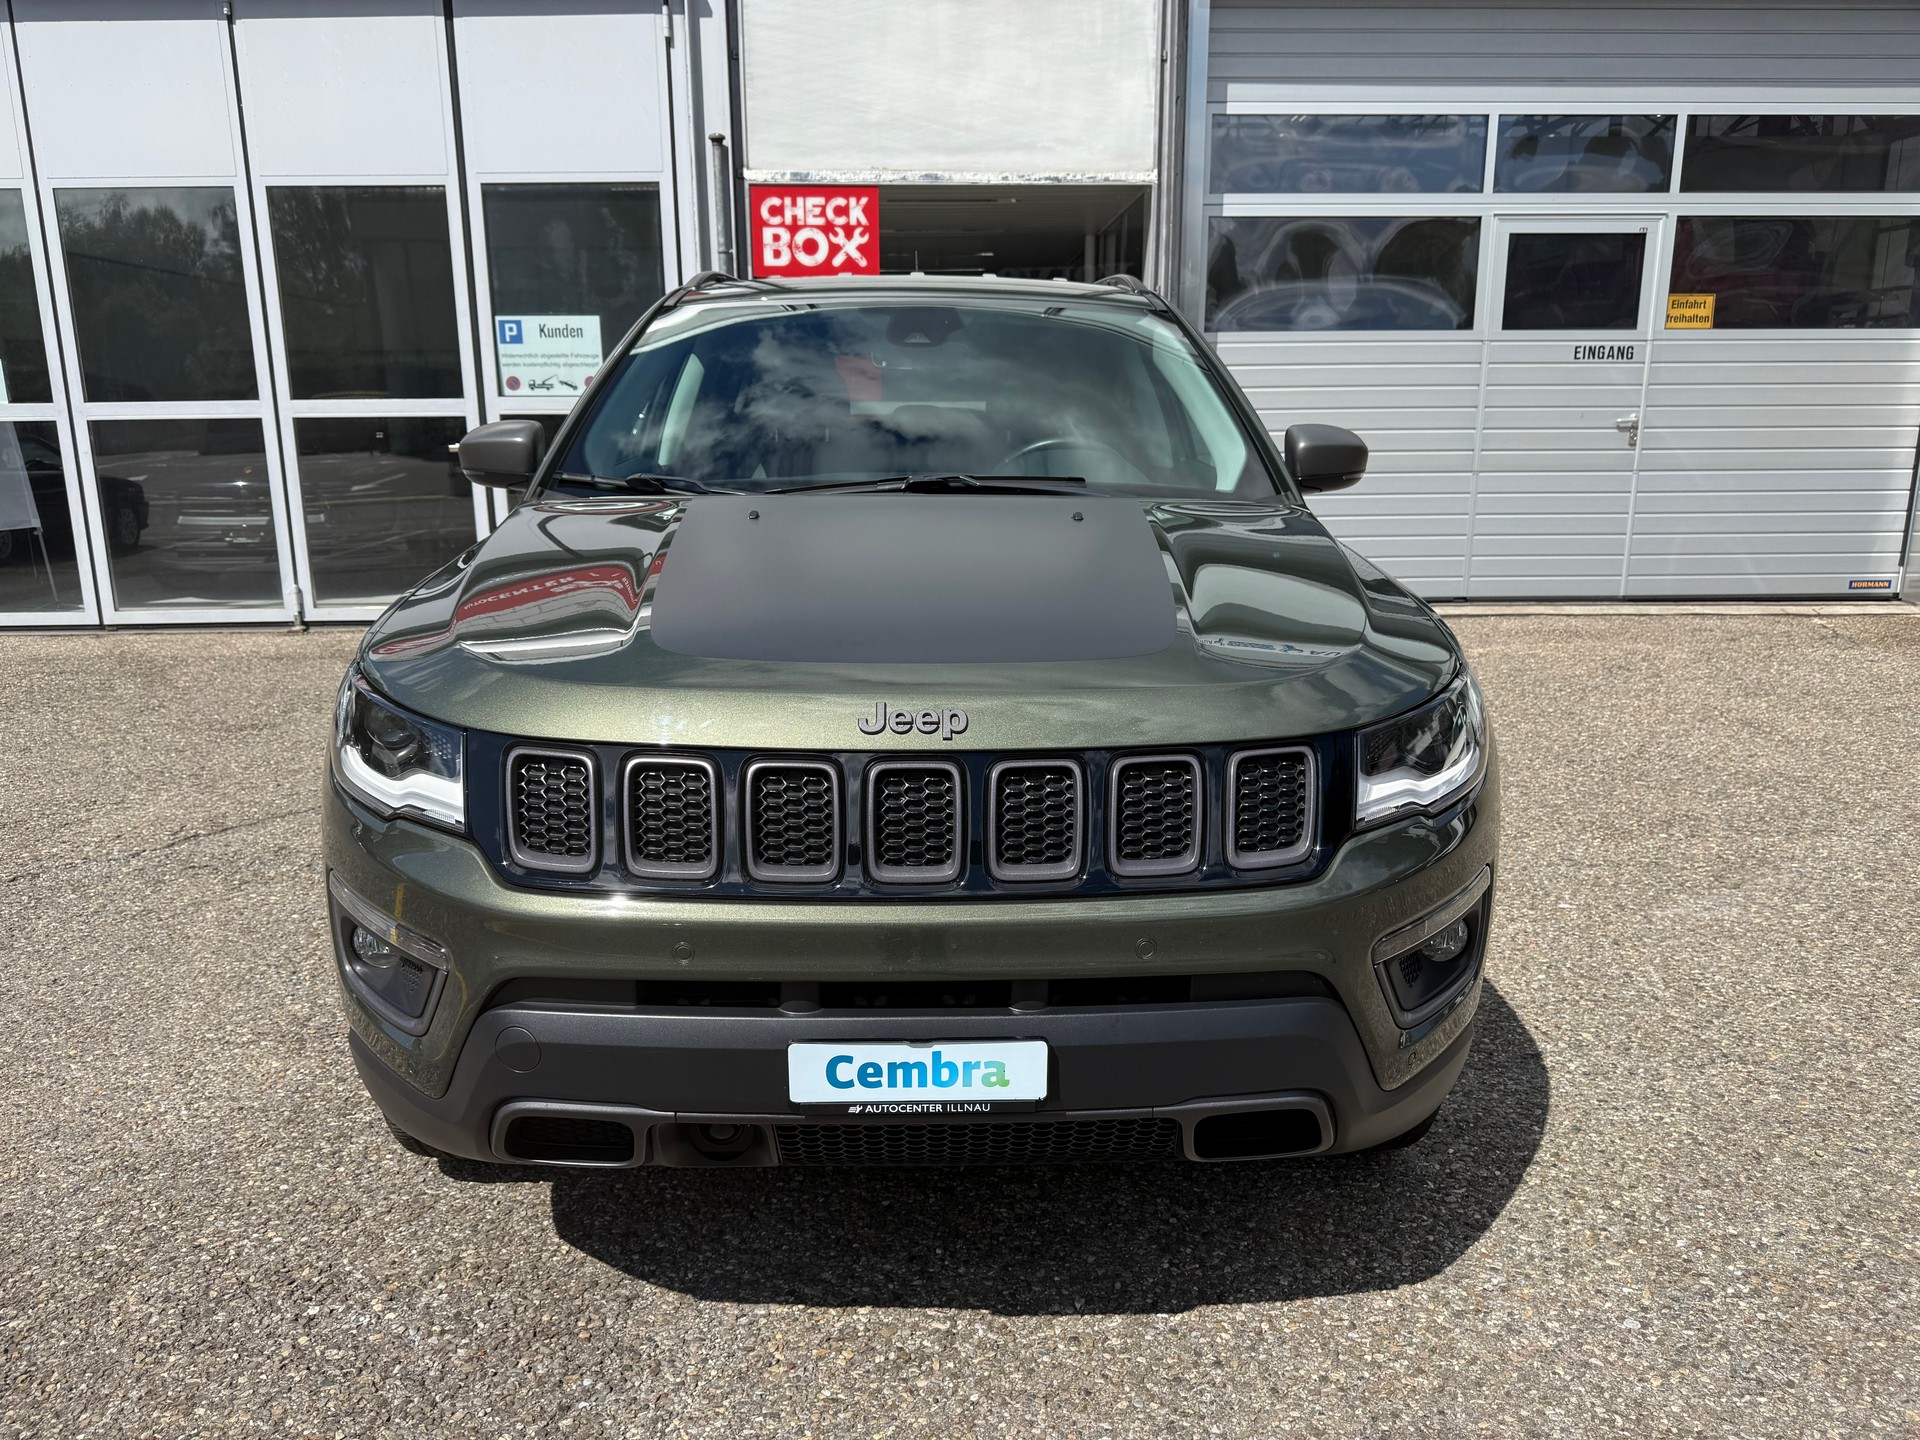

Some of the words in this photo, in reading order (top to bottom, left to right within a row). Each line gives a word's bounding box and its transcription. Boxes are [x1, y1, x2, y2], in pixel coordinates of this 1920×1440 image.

[760, 196, 870, 226] CHECK
[762, 226, 870, 268] BOX
[1671, 299, 1707, 310] Einfahrt
[1666, 313, 1710, 324] freihalten
[504, 323, 518, 342] P
[538, 323, 584, 339] Kunden
[570, 352, 599, 360] Fahrzeuge
[1573, 345, 1635, 361] EINGANG
[857, 701, 969, 741] Jeep
[825, 1050, 1010, 1090] Cembra
[865, 1104, 943, 1114] AUTOCENTER
[946, 1103, 991, 1113] ILLNAU
